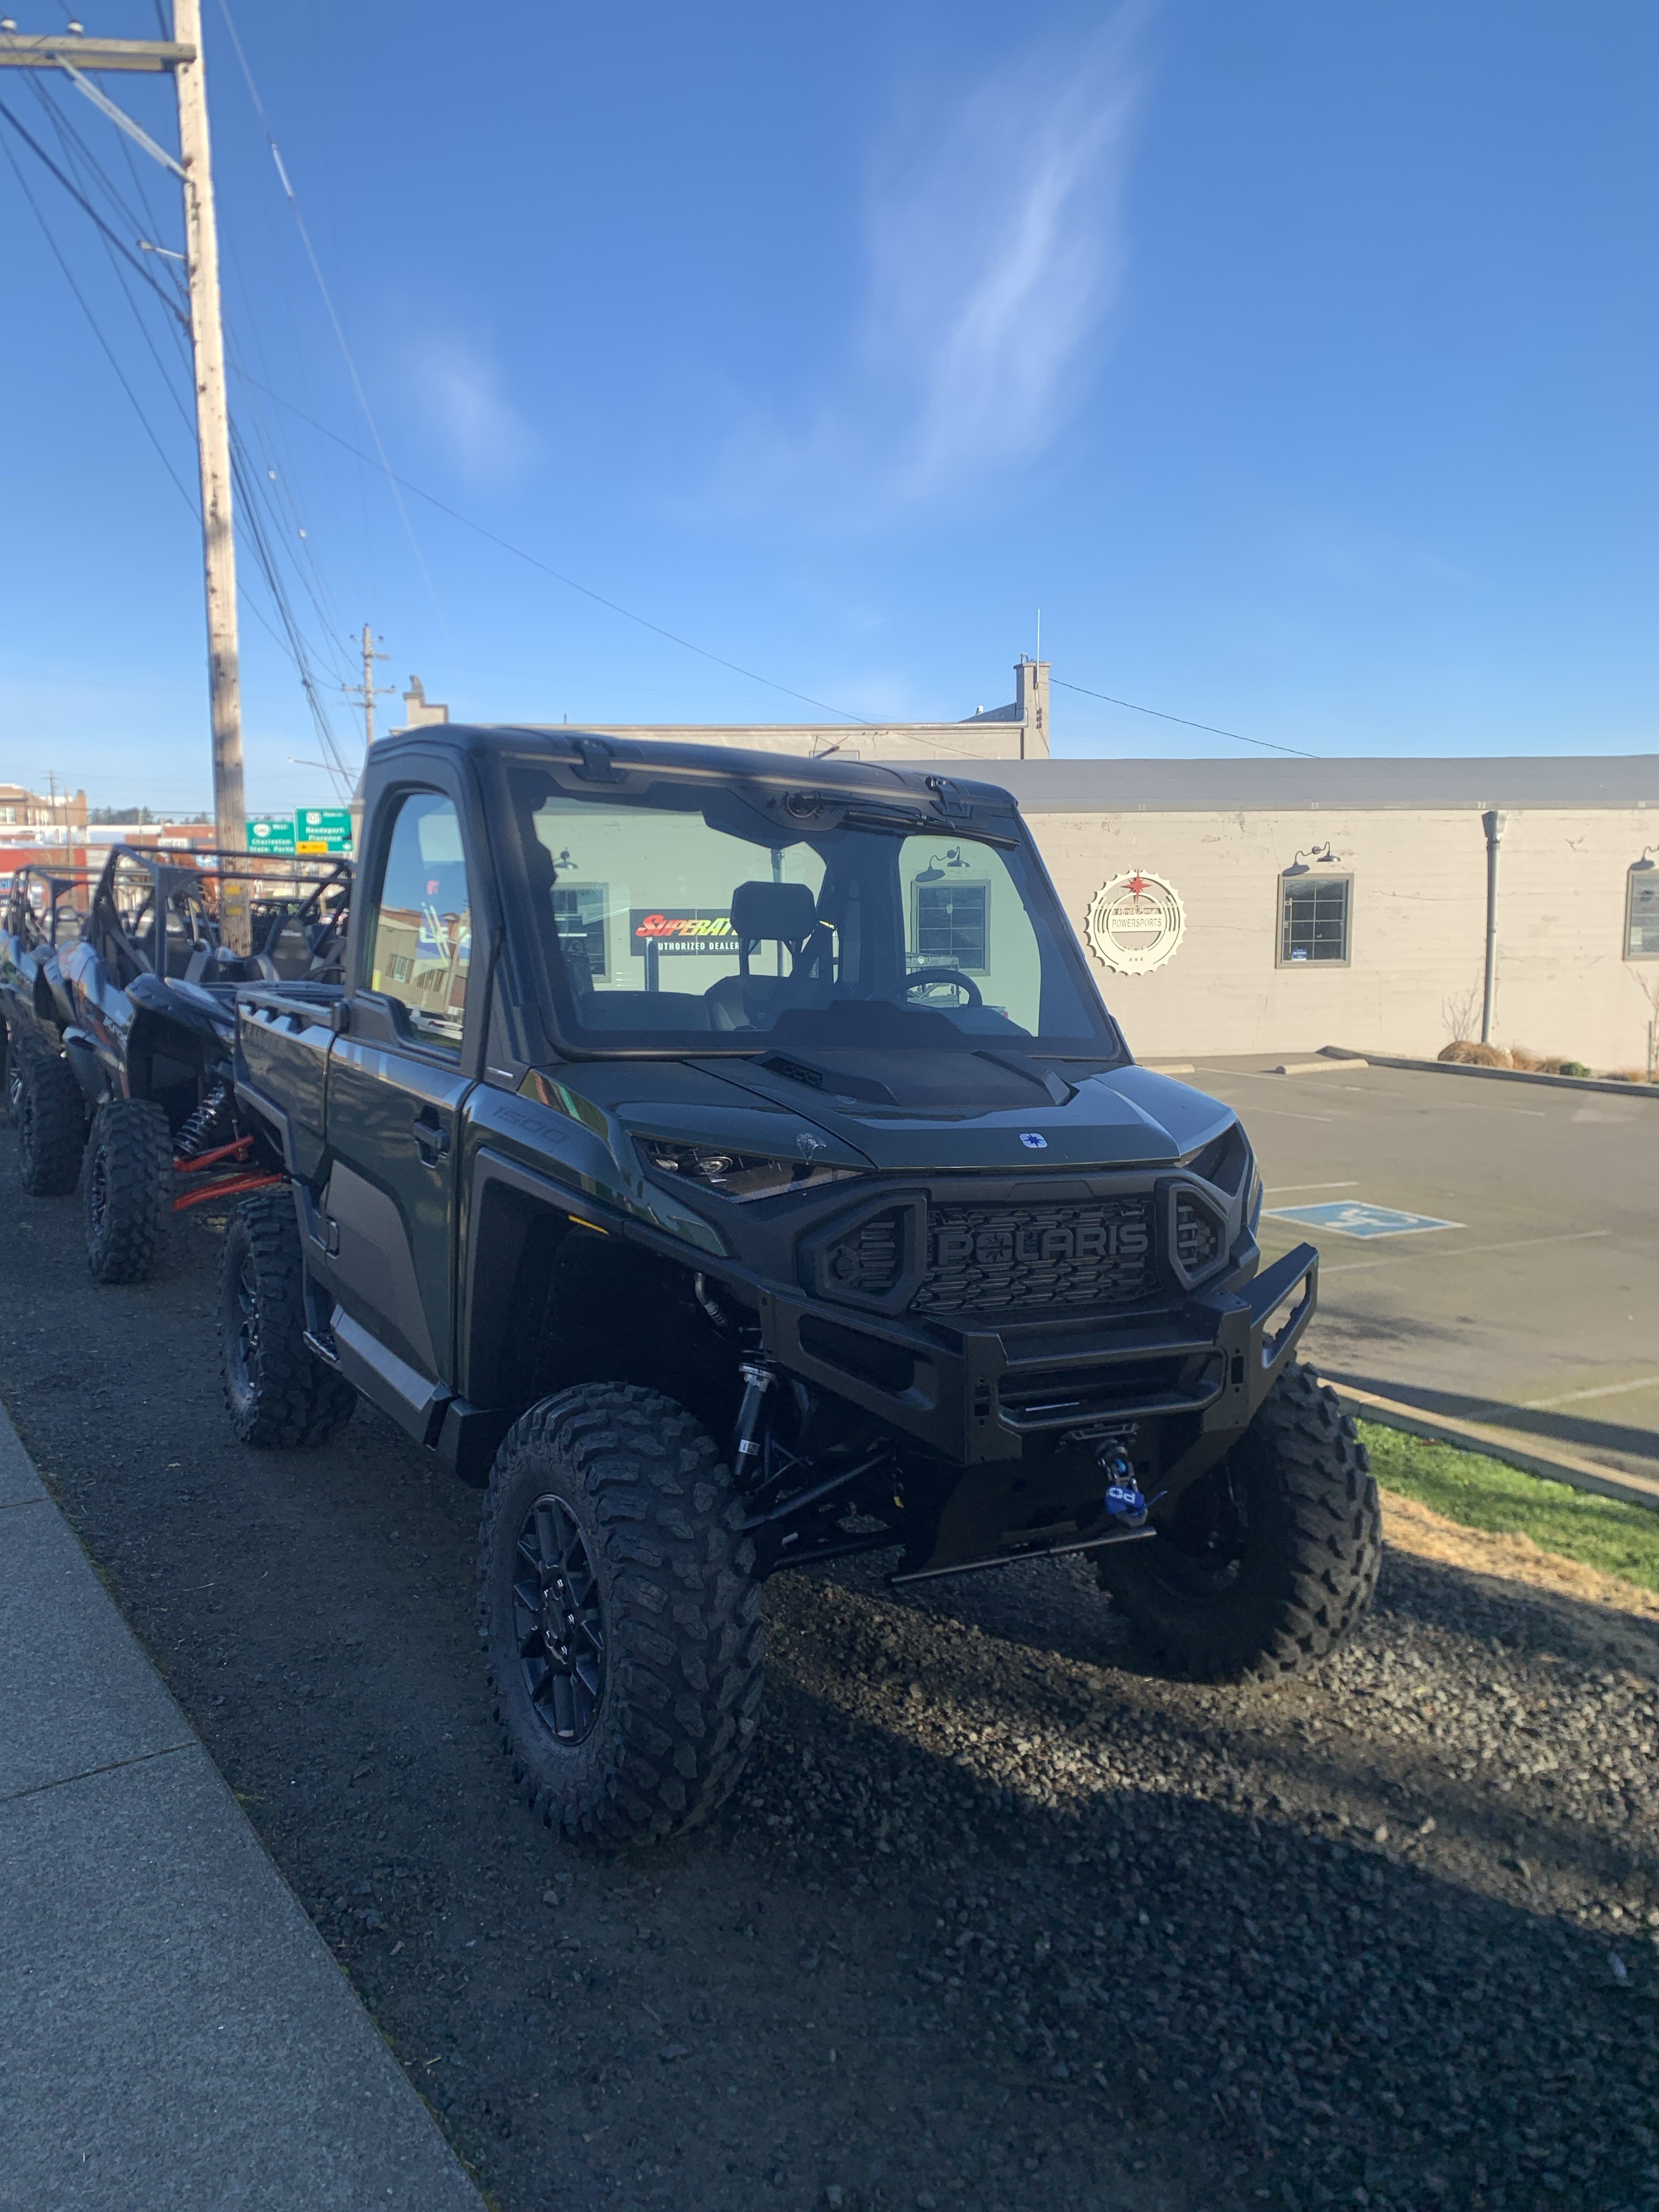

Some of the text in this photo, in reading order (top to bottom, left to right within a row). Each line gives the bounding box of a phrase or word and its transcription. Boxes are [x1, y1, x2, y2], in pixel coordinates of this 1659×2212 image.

[635, 914, 738, 936] SUPERAT
[1112, 918, 1162, 928] POWERSPORTS
[658, 942, 740, 950] UTHORIZED DEALER
[938, 1223, 1149, 1266] POLARIS
